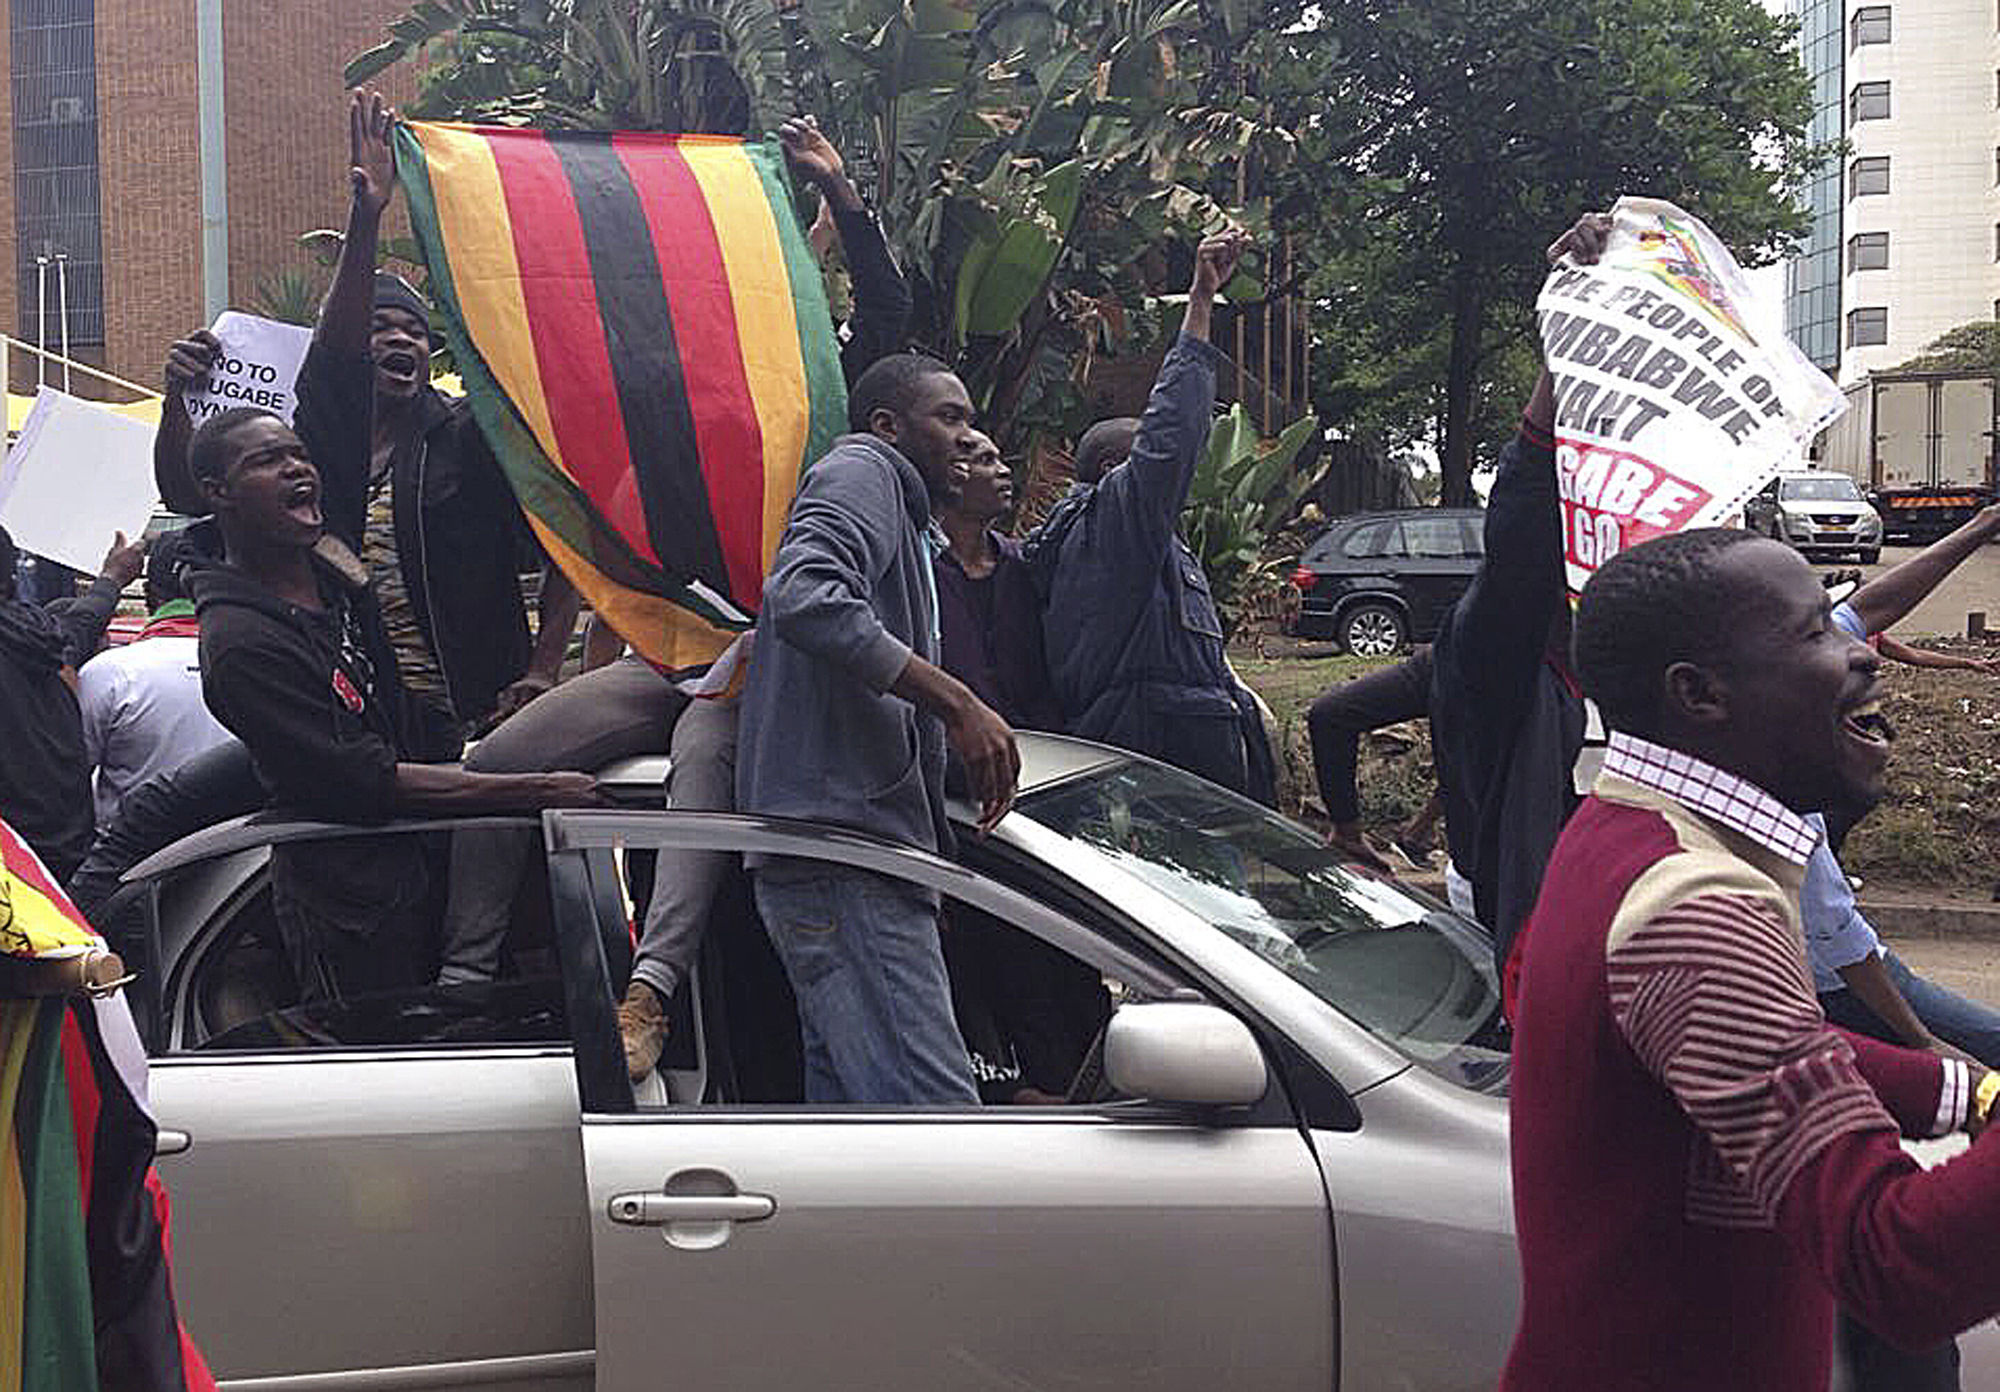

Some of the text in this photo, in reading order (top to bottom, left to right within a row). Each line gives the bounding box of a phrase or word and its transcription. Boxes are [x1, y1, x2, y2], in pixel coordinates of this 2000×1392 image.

[210, 354, 277, 384] NO TO
[1540, 309, 1761, 446] MBABWE
[1600, 286, 1746, 378] PEOPLE
